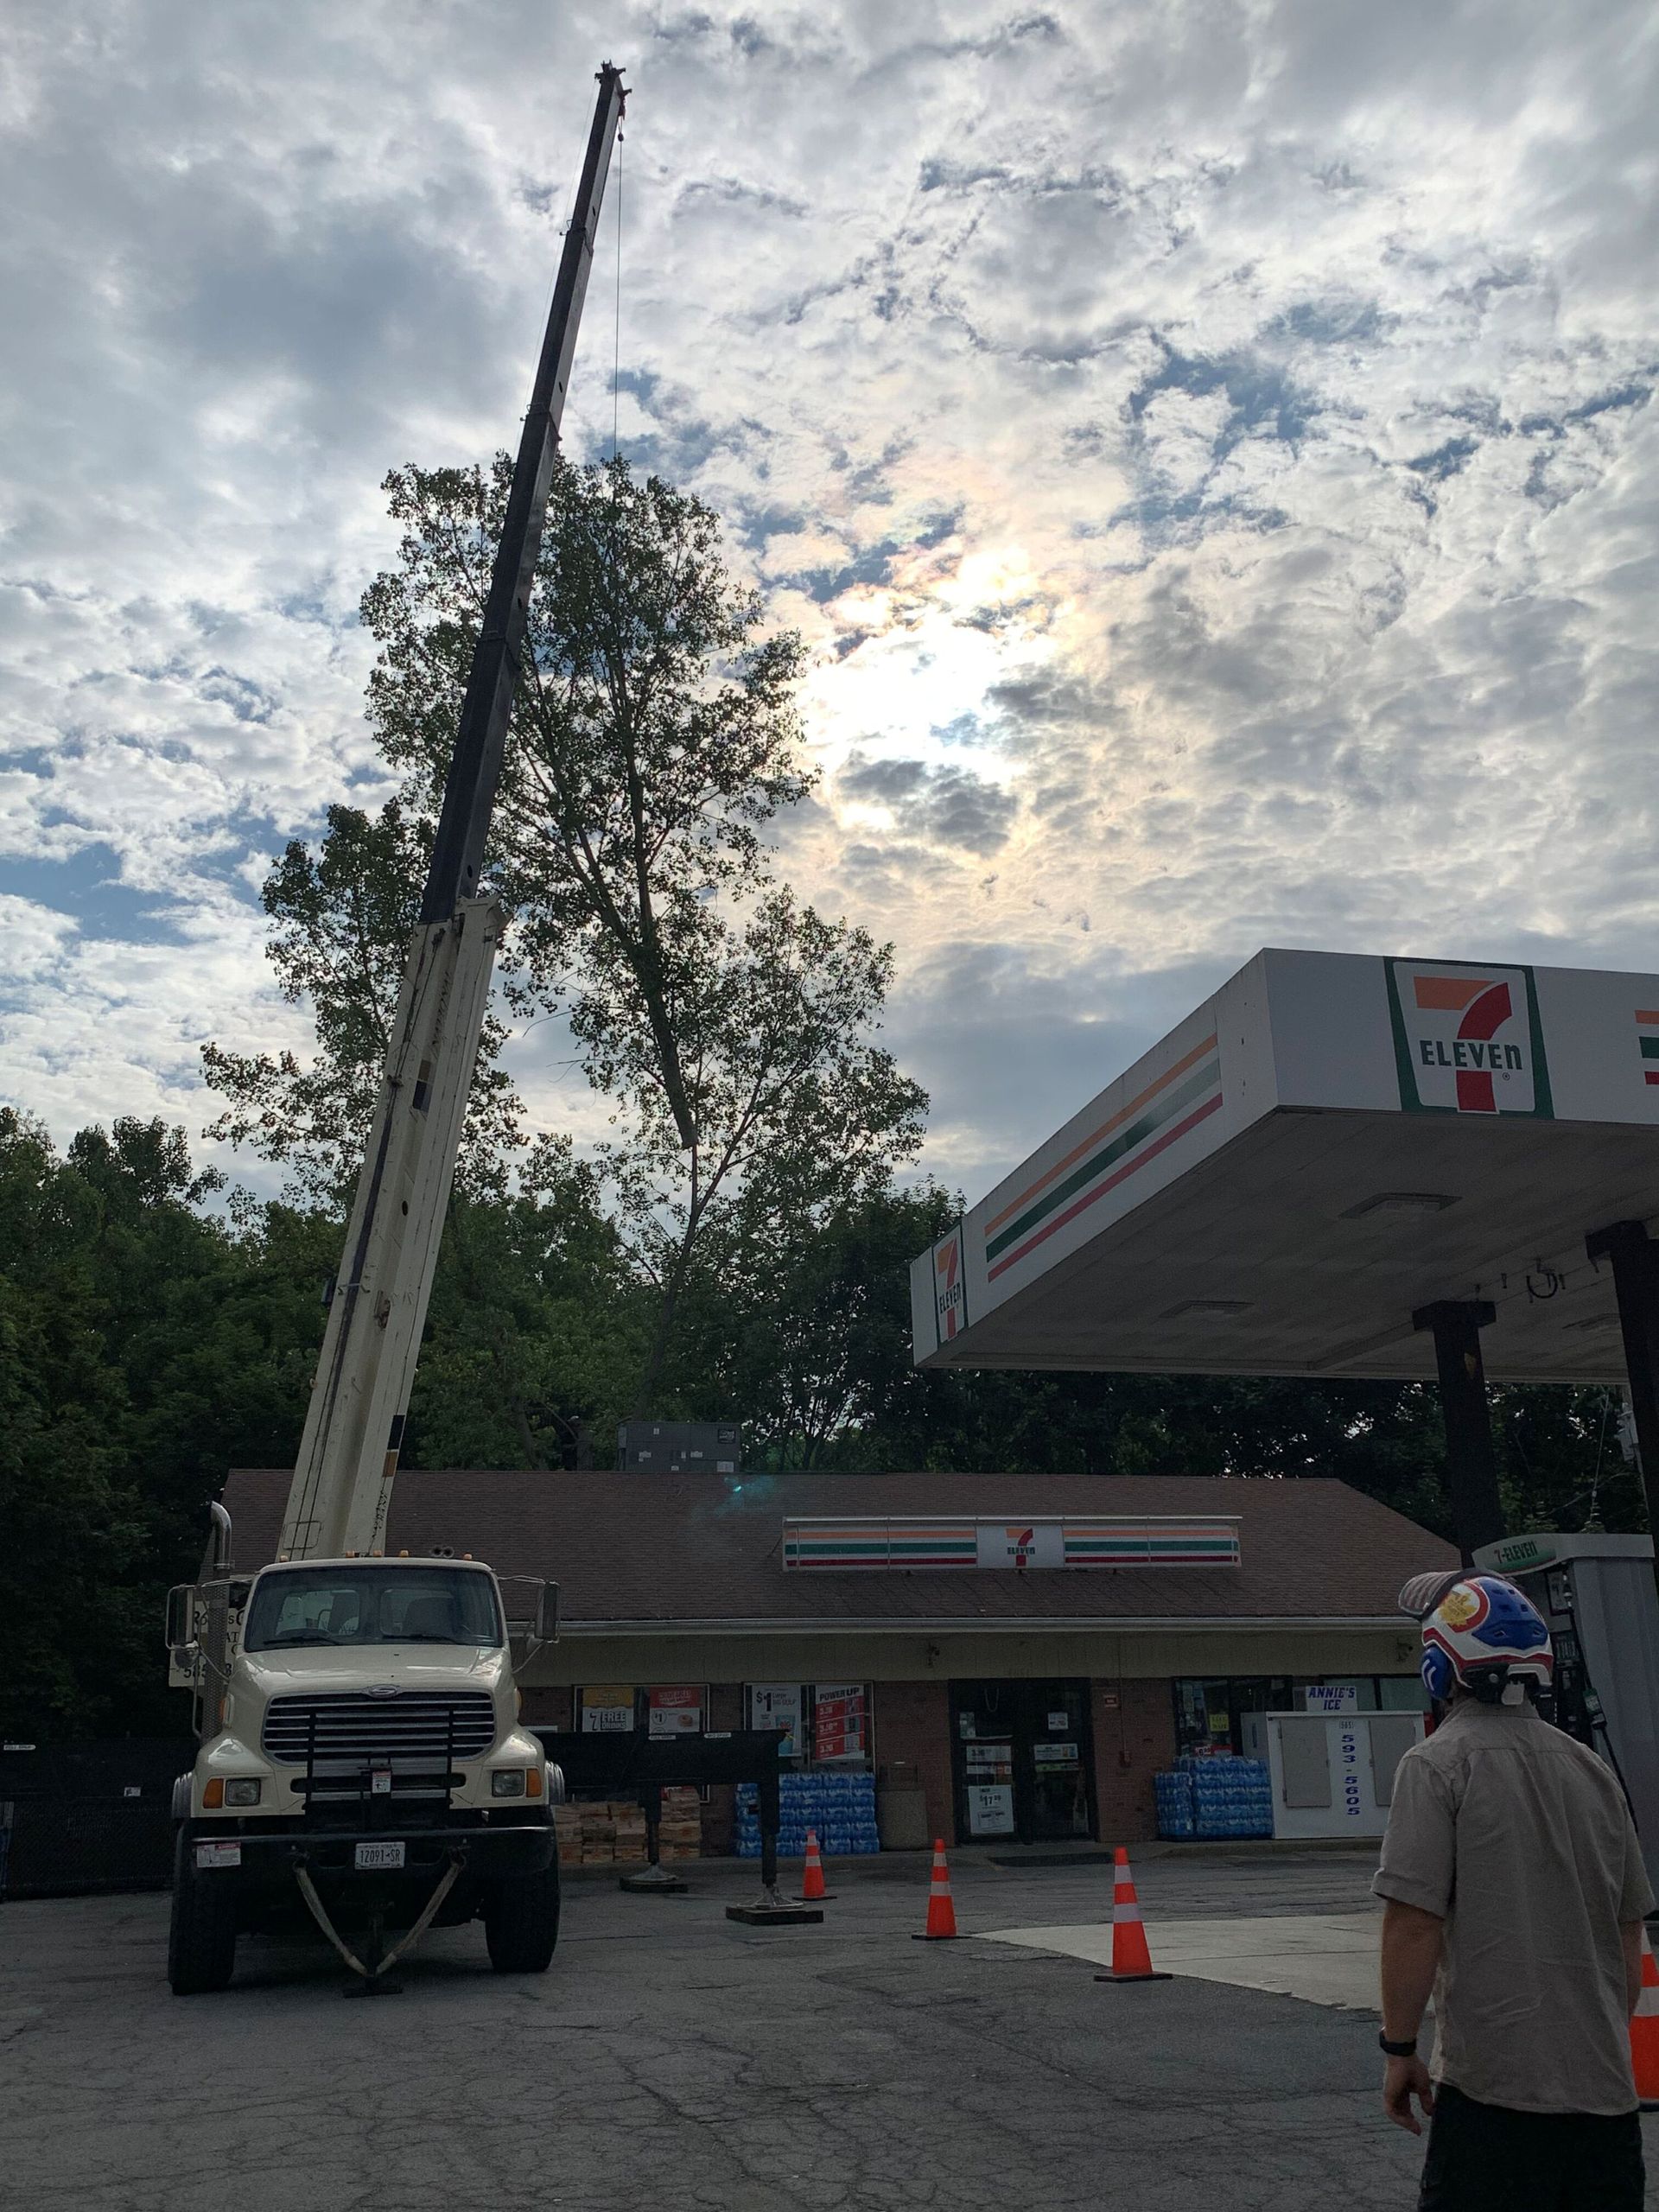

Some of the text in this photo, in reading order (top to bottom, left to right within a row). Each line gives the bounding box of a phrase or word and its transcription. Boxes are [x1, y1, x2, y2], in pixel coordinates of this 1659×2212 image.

[1414, 976, 1513, 1113] 7
[937, 1236, 959, 1341] 7
[1006, 1528, 1033, 1567] 7
[756, 1690, 772, 1712] $1
[819, 1687, 860, 1701] POWER UP
[1307, 1687, 1356, 1699] ANNIE'S
[1323, 1699, 1342, 1710] ICE
[601, 1711, 626, 1721] FREE
